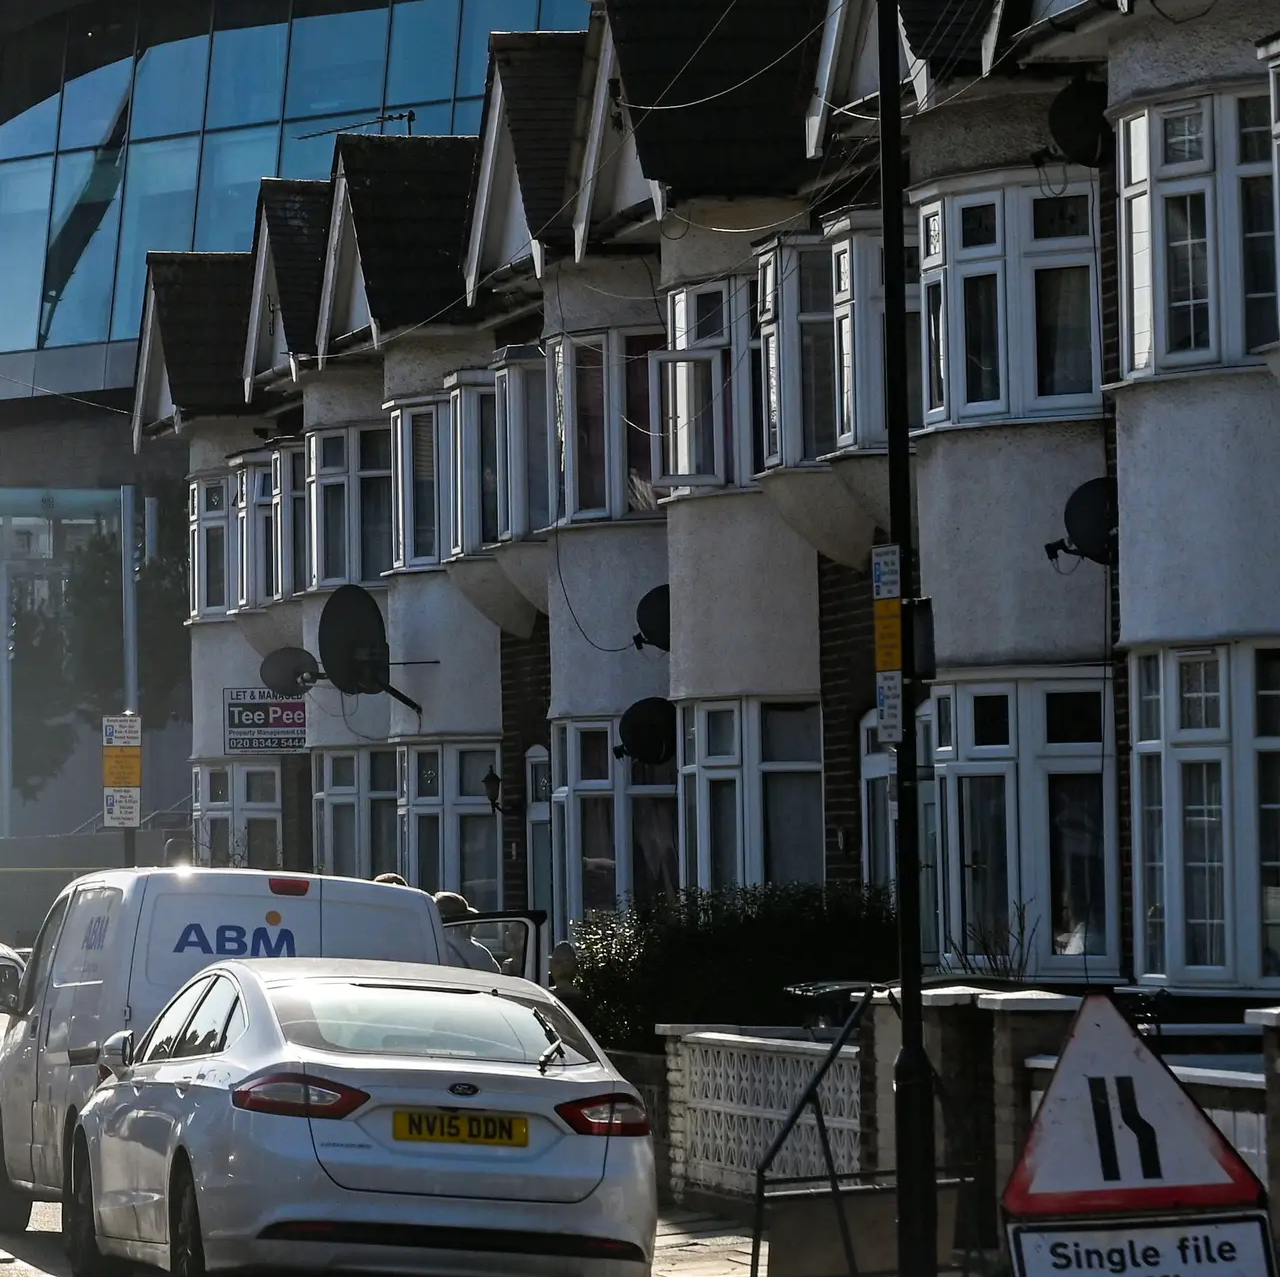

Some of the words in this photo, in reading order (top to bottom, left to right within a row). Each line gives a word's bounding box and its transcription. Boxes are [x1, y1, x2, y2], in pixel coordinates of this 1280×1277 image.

[230, 690, 247, 701] LET
[249, 690, 256, 701] &
[229, 707, 265, 724] Tee
[268, 706, 305, 724] Pee
[228, 729, 255, 737] Property
[230, 739, 250, 748] 020
[252, 739, 279, 748] 8342
[281, 739, 305, 747] 5444
[80, 915, 110, 951] ABM
[172, 922, 297, 958] ABM
[408, 1112, 461, 1138] NV15
[468, 1117, 513, 1141] DDN
[1049, 1239, 1161, 1273] Single
[1176, 1235, 1237, 1264] file
